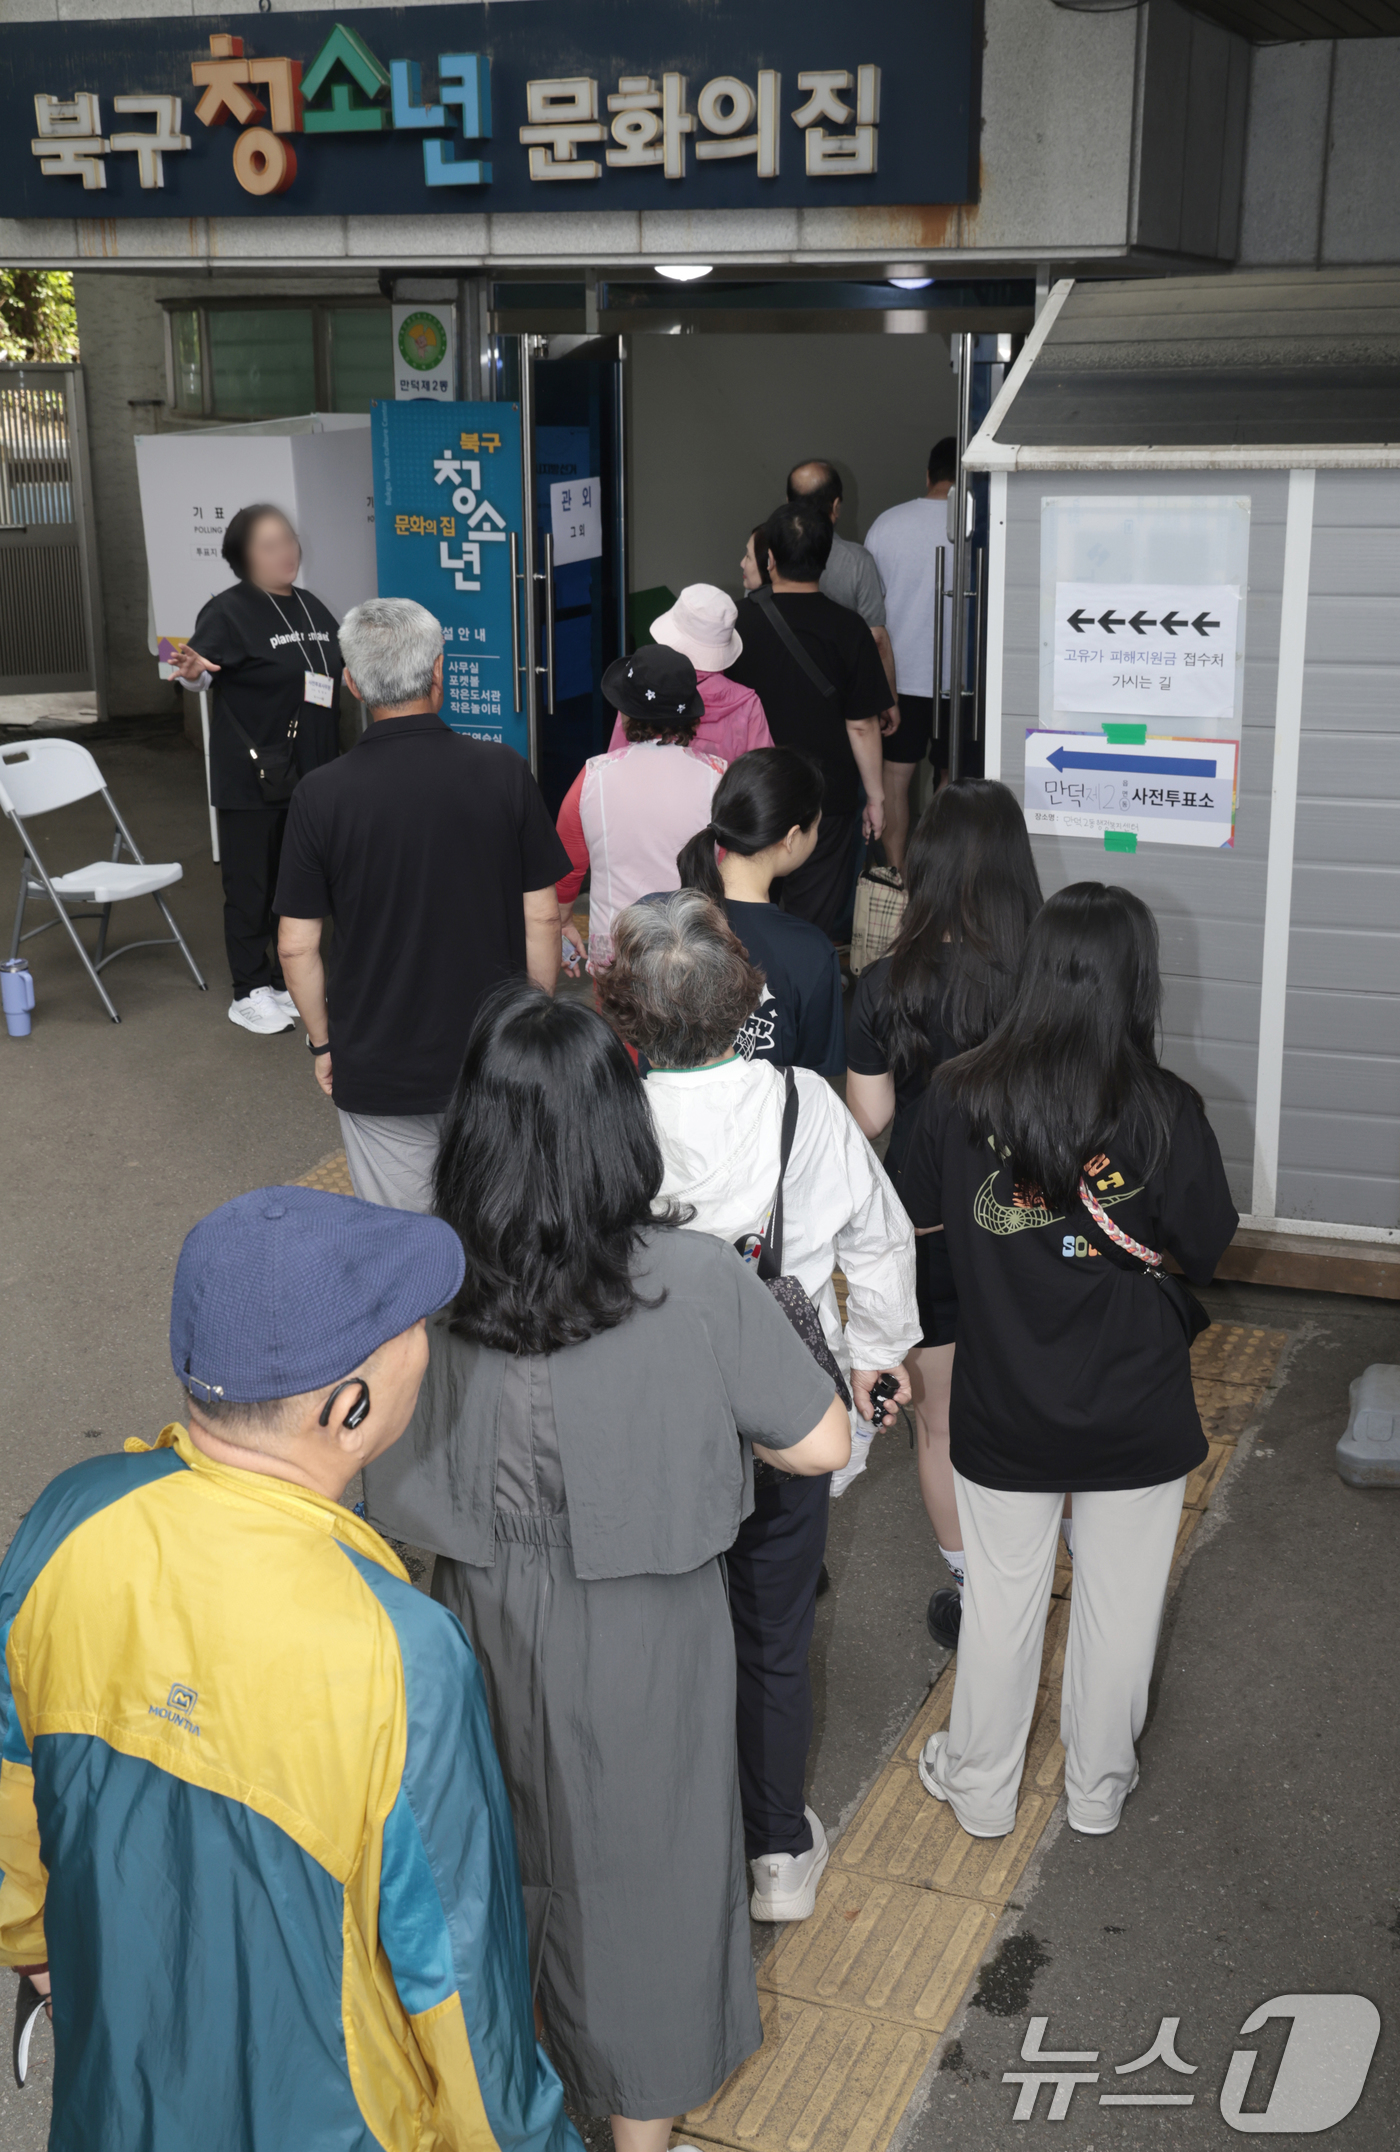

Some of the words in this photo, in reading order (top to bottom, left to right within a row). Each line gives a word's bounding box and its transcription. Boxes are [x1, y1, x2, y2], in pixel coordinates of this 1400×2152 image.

[31, 92, 191, 189] 북구
[191, 23, 492, 196] 청소년
[400, 379, 448, 393] 만덕제2동
[460, 432, 501, 453] 북구
[394, 515, 437, 536] 문화의
[439, 516, 456, 537] 집
[433, 450, 507, 591] 청소년
[194, 526, 223, 534] POLLING
[1063, 649, 1104, 664] 고유가
[1109, 650, 1177, 667] 피해지원금
[1183, 652, 1224, 668] 접수처
[449, 661, 479, 674] 사무실
[449, 675, 480, 687] 포켓볼
[1111, 674, 1153, 690] 가시는
[1158, 676, 1172, 691] 길
[449, 688, 501, 702] 작은도서관
[450, 702, 501, 715] 작은놀이터
[1131, 788, 1215, 808] 사전투표소
